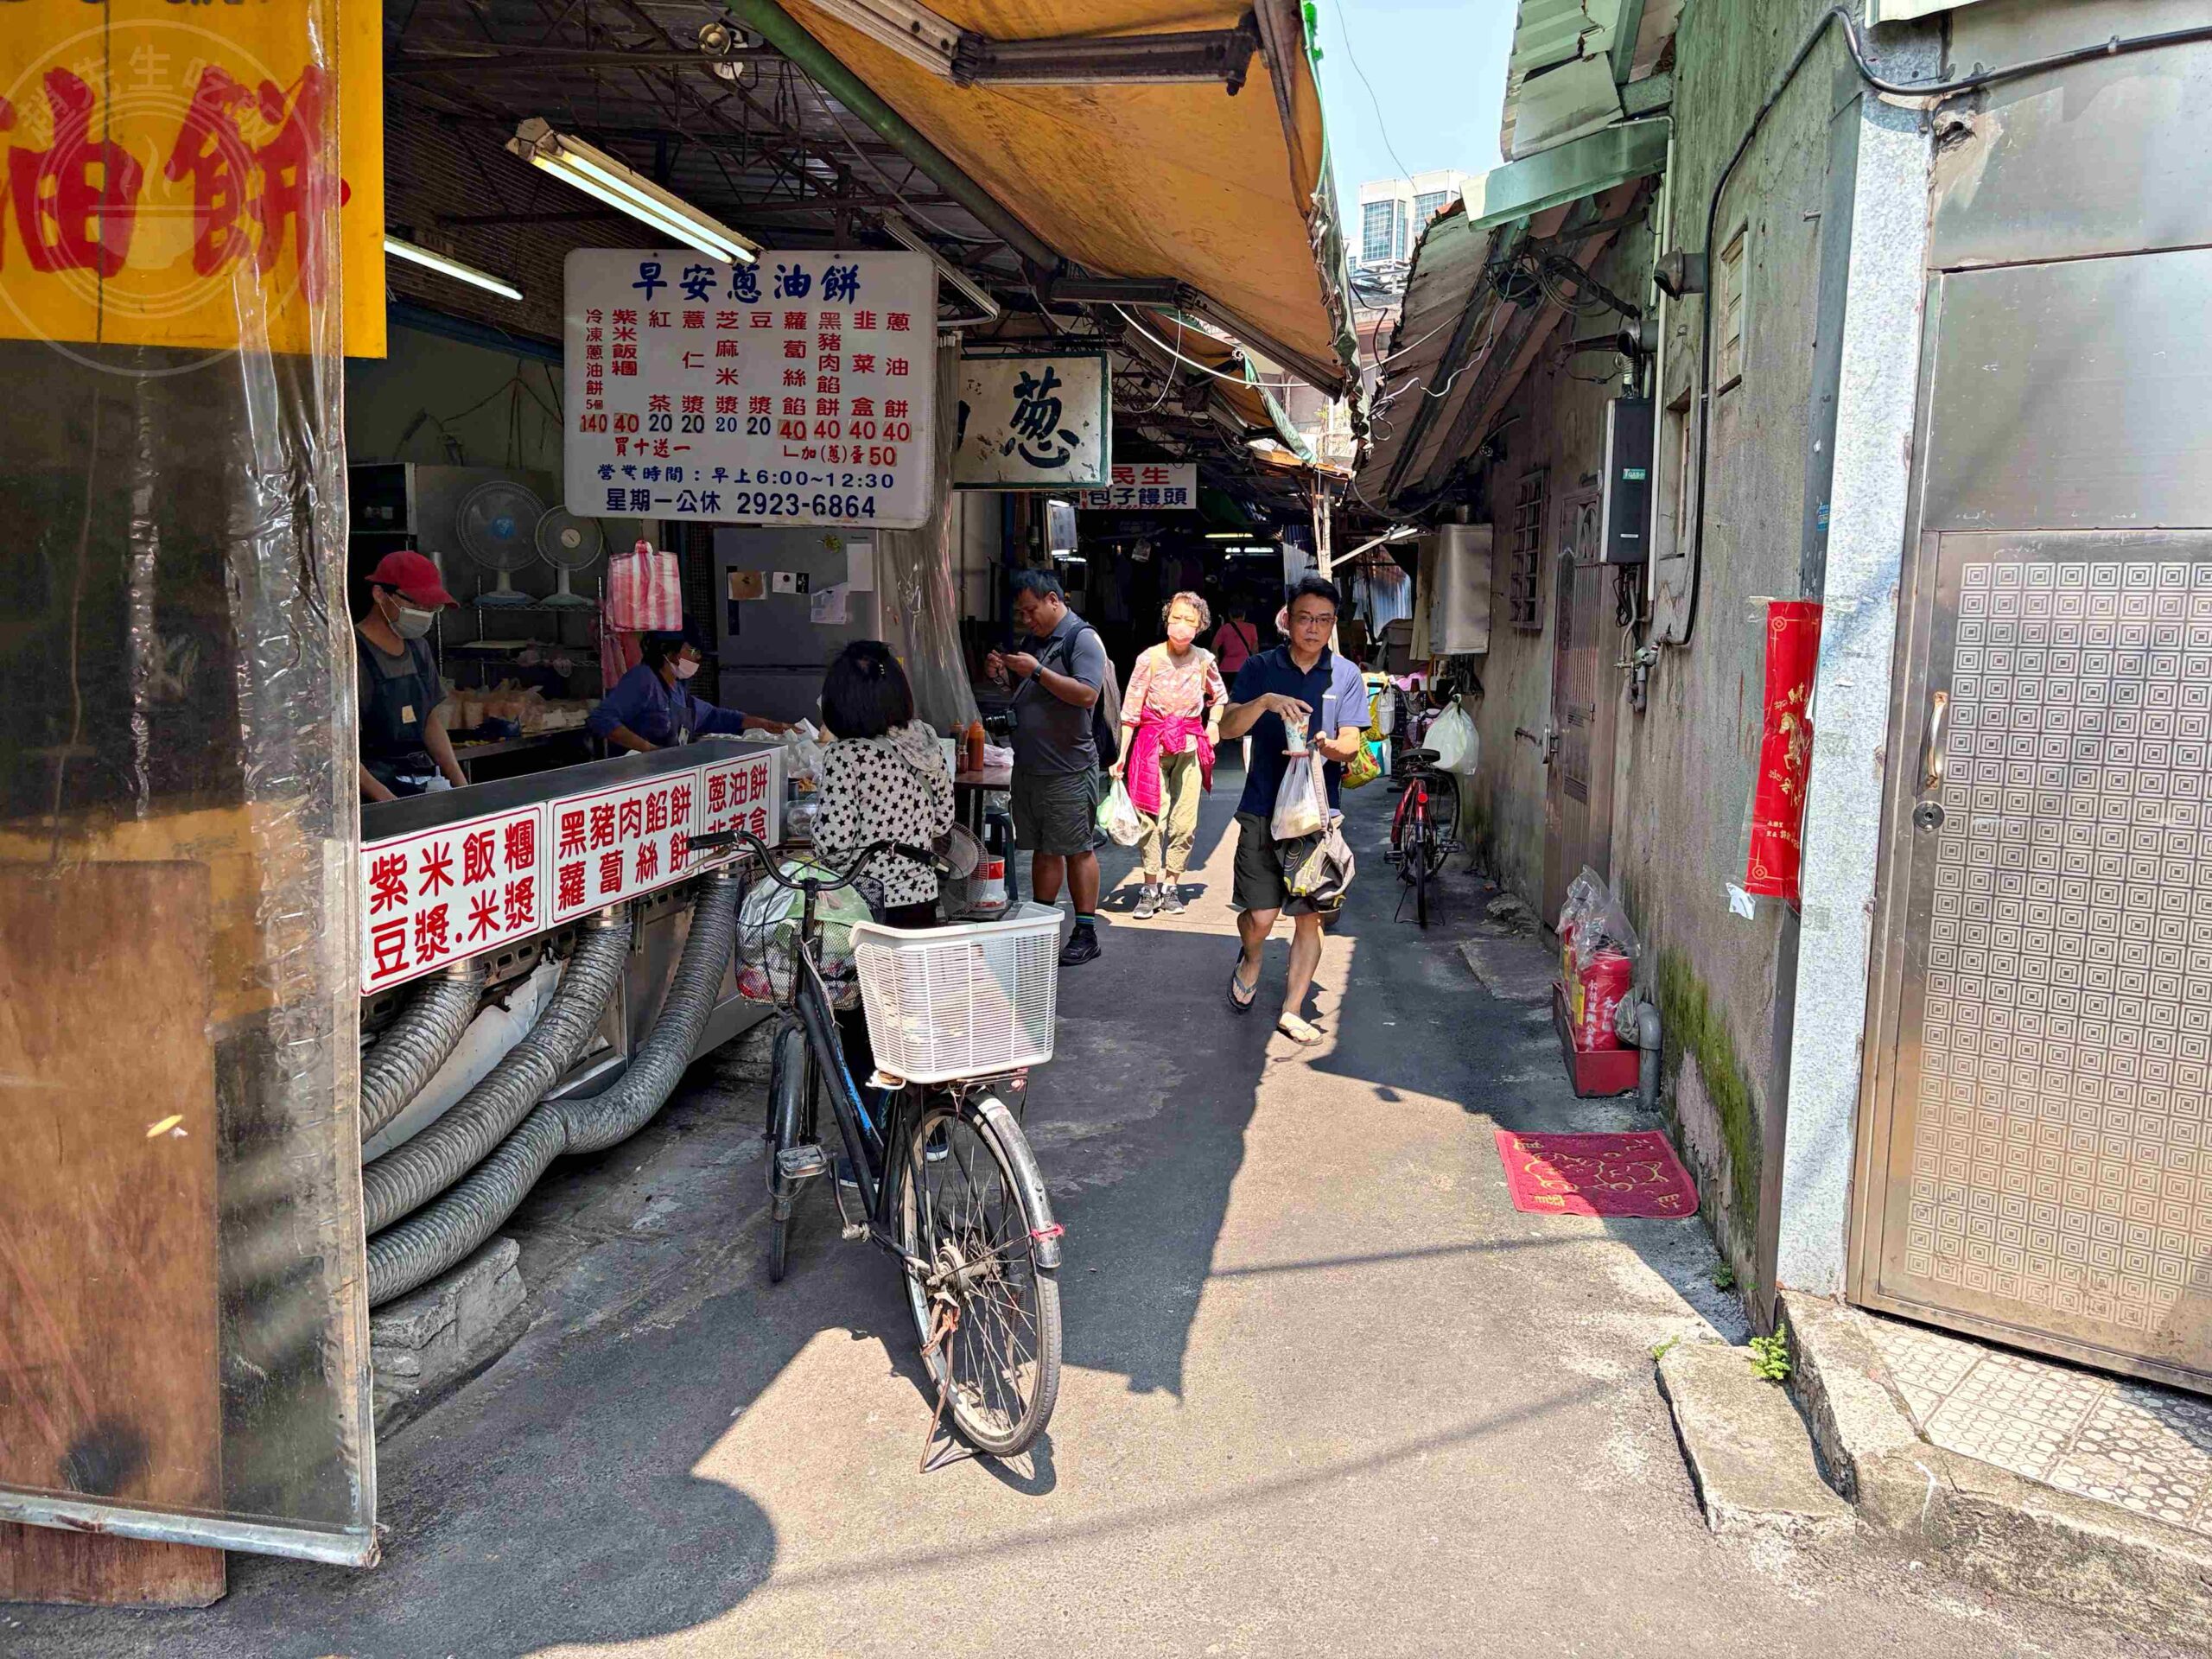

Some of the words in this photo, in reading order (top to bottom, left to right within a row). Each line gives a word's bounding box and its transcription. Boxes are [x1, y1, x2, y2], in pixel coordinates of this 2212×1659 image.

[632, 262, 861, 303] 早安蔥油餅
[612, 308, 638, 376] 紫米飯糰
[580, 414, 607, 433] 140
[613, 414, 639, 433] 40
[649, 414, 672, 432] 20
[681, 415, 705, 433] 20
[715, 416, 737, 432] 20
[747, 416, 771, 435] 20
[779, 421, 806, 440] 40
[813, 420, 841, 439] 40
[849, 421, 876, 440] 40
[882, 423, 910, 442] 40
[614, 436, 692, 458] 買十送一
[606, 488, 721, 512] 星期一公休
[737, 492, 875, 518] 2923-6864
[1088, 487, 1187, 505] 包子饅頭
[558, 783, 691, 860] 黑豬肉餡餅
[370, 819, 534, 915] 紫米飯糰
